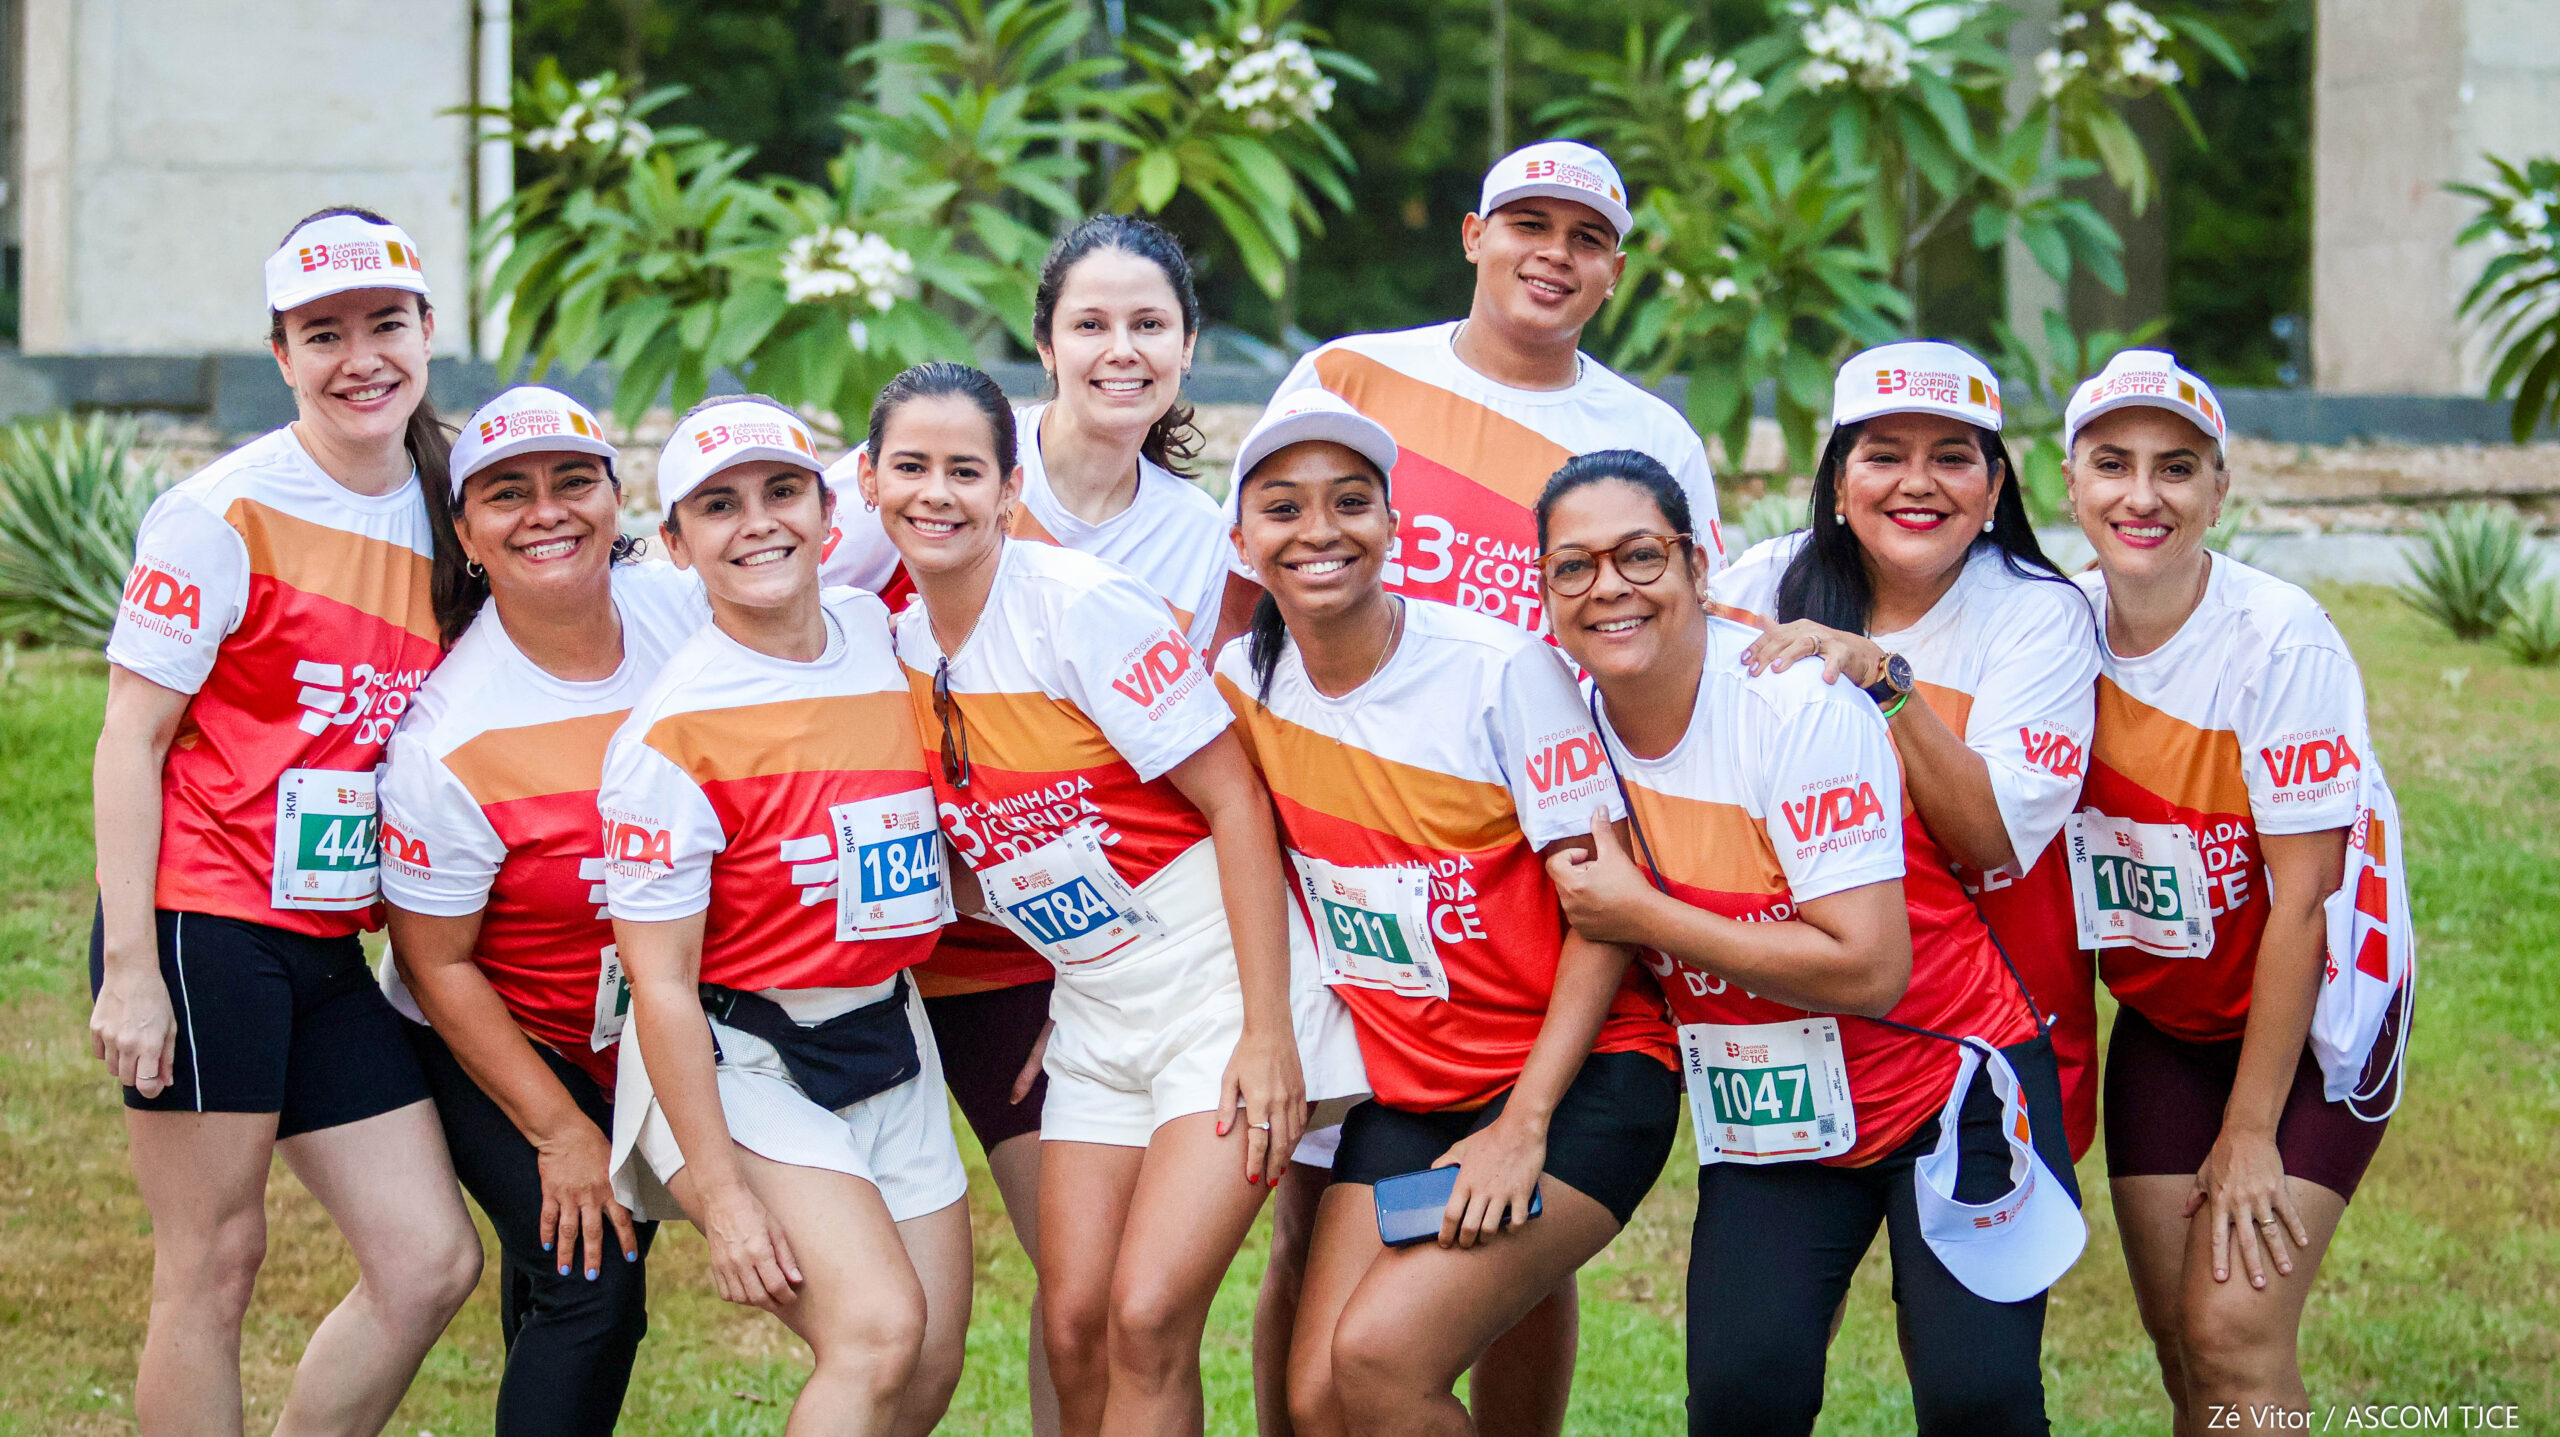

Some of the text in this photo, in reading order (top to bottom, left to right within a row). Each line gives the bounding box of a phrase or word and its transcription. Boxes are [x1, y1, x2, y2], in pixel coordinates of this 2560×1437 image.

[1556, 175, 1572, 184] DO
[333, 241, 380, 251] CAMINHADA
[333, 256, 382, 271] DO TJCE
[1912, 371, 1960, 382] CAMINHADA
[2114, 384, 2129, 395] DO
[1909, 386, 1958, 404] DO TJCE
[510, 425, 527, 438] DO
[734, 434, 785, 447] DO TJCE
[144, 553, 191, 580] PROGRAMA
[124, 564, 201, 630] VIDA
[1456, 582, 1507, 617] DO
[1112, 629, 1200, 708] VIDA
[1148, 702, 1168, 721] em
[353, 718, 396, 746] DO
[1537, 724, 1587, 745] PROGRAMA
[2281, 726, 2337, 742] PROGRAMA
[1526, 731, 1611, 793] VIDA
[2019, 727, 2084, 779] VIDA
[2260, 734, 2361, 788] VIDA
[1801, 772, 1860, 793] PROGRAMA
[285, 791, 297, 819] 3KM
[1537, 794, 1559, 810] em
[2272, 791, 2294, 804] em
[607, 807, 660, 826] PROGRAMA
[1781, 781, 1885, 843] VIDA
[315, 816, 377, 866] 442
[602, 818, 675, 870] VIDA
[844, 825, 856, 853] 5KM
[993, 835, 1037, 862] DO
[2073, 836, 2087, 863] 3KM
[863, 834, 940, 897] 1844
[1796, 845, 1817, 860] em
[1305, 876, 1320, 902] 3KM
[2098, 859, 2179, 917] 1055
[869, 911, 885, 919] TJCE
[988, 890, 1006, 914] 5KM
[1018, 880, 1112, 939] 1784
[1333, 906, 1395, 959] 911
[606, 963, 618, 986] 3KM
[1683, 971, 1727, 997] DO
[1689, 1047, 1703, 1075] 3KM
[1750, 1054, 1769, 1064] TJCE
[1713, 1068, 1807, 1121] 1047
